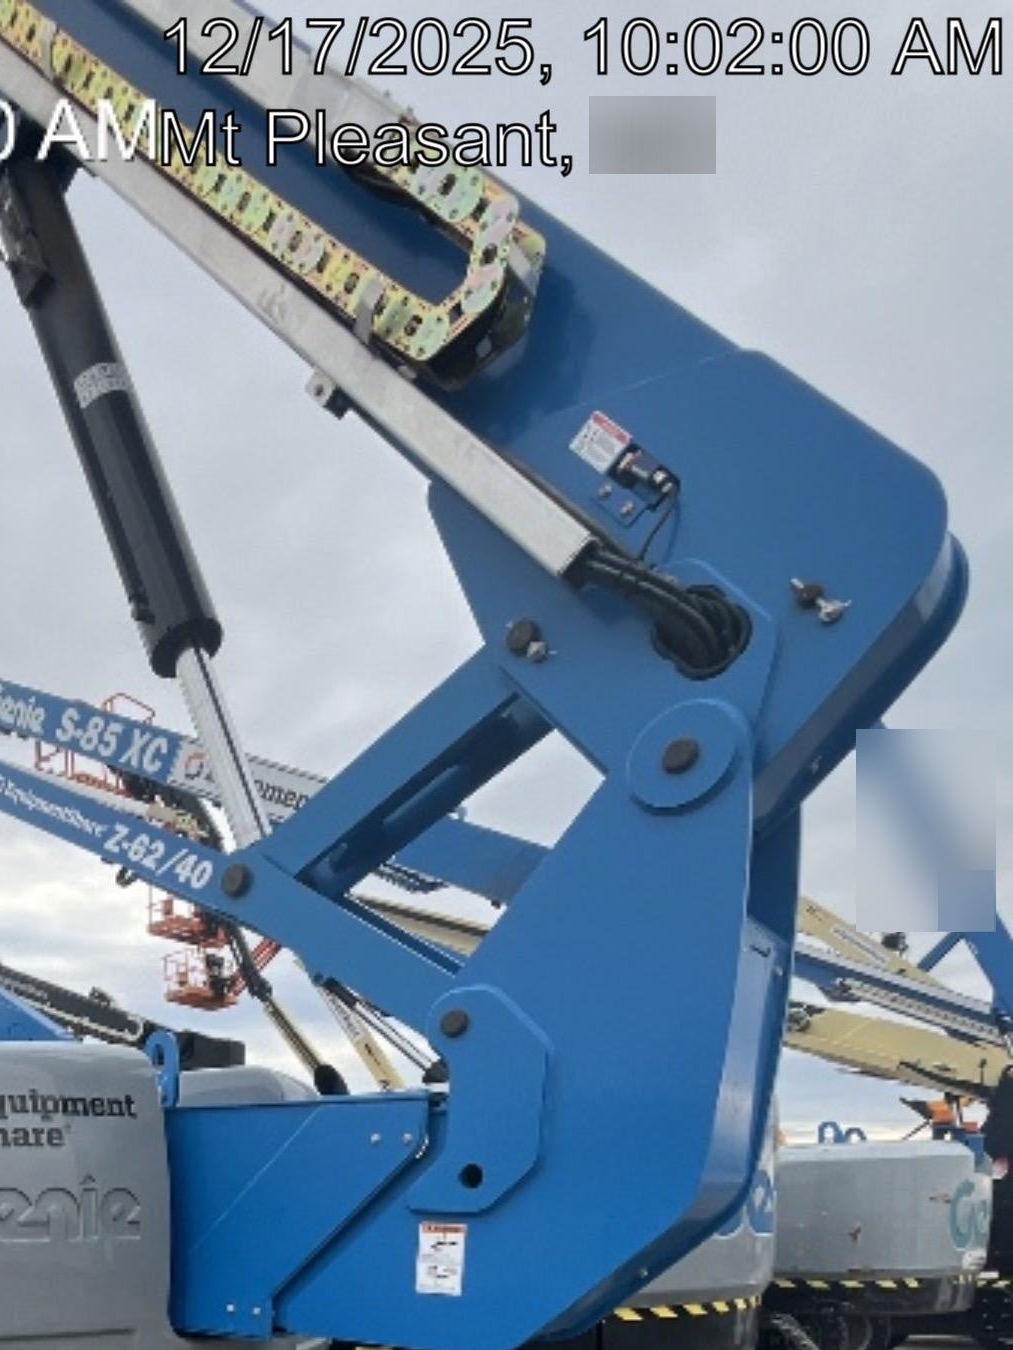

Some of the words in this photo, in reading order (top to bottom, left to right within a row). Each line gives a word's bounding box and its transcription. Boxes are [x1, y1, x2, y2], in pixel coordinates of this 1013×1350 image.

[55, 706, 124, 758] S-85
[122, 729, 169, 774] XC
[102, 824, 214, 890] Z-62/40
